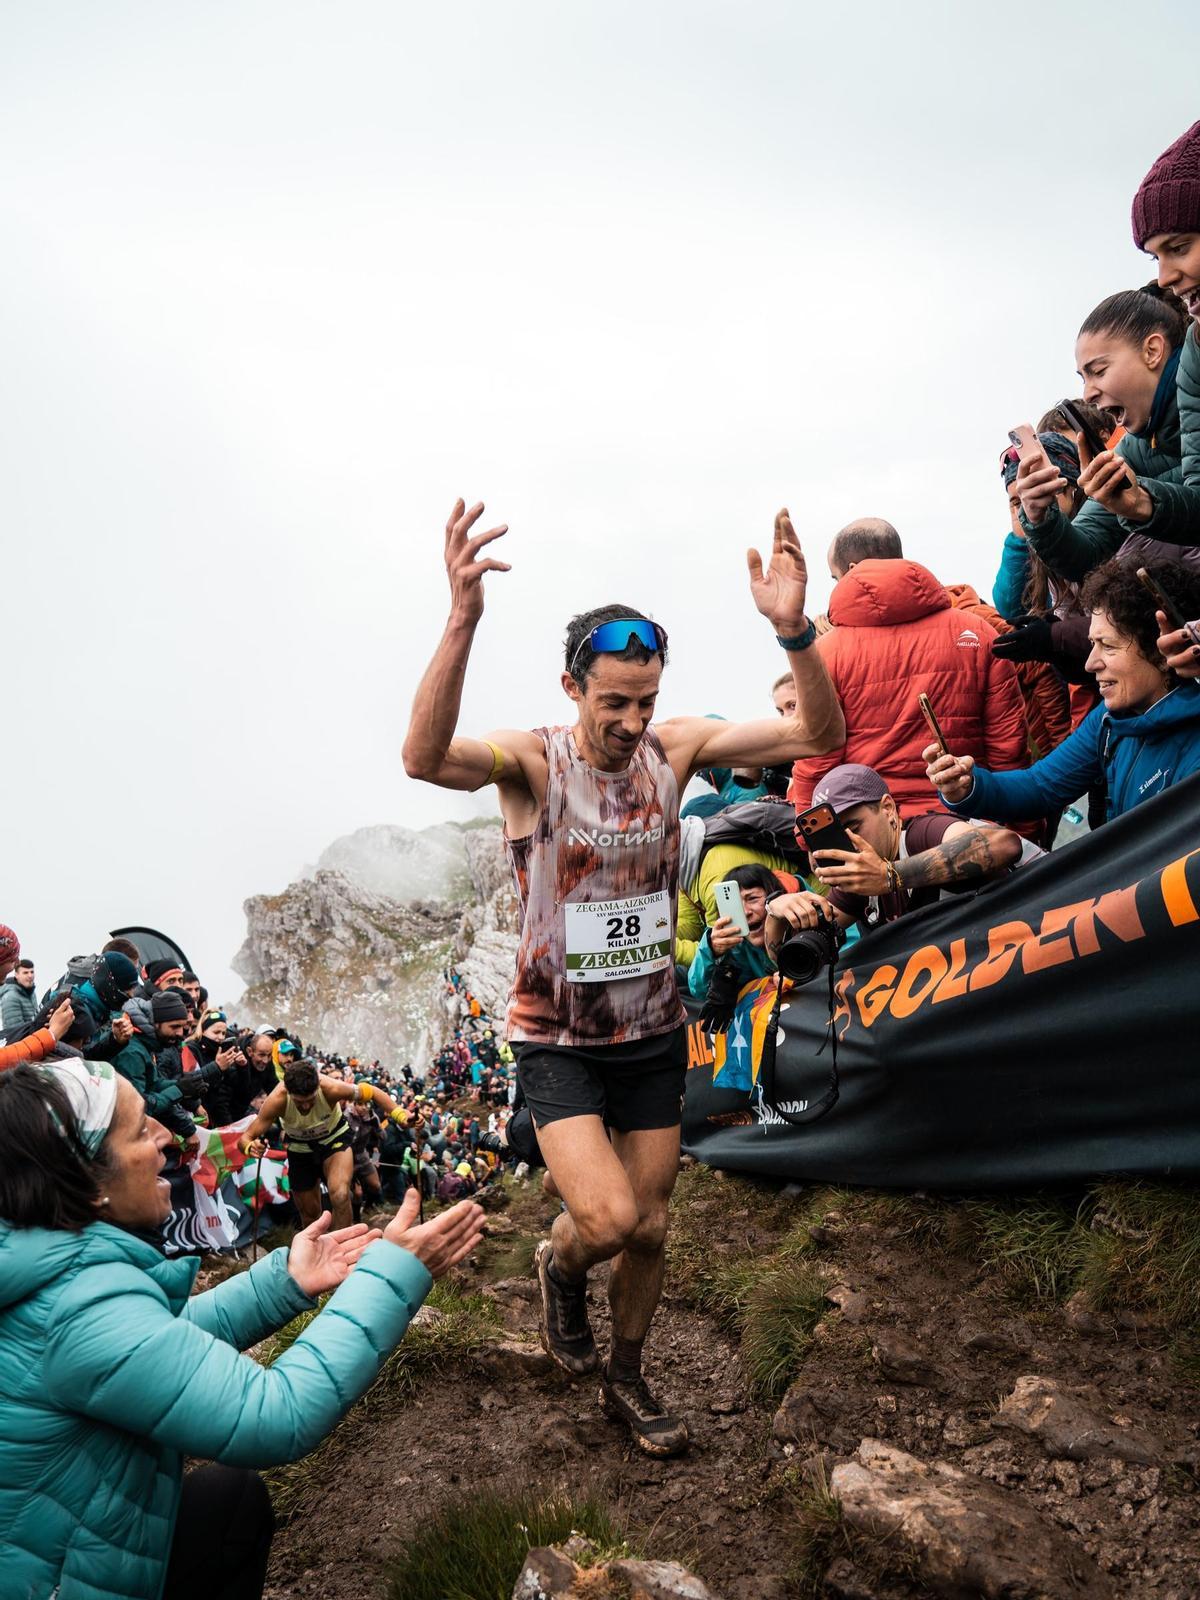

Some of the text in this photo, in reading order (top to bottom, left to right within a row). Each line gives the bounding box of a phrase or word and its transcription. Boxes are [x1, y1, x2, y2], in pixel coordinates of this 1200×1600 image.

[576, 893, 664, 913] ZEGAMA-AIZKORRI
[606, 915, 641, 940] 28
[607, 937, 640, 948] KILIAN
[580, 944, 662, 969] ZEGAMA
[855, 880, 1146, 1028] GOLDEN
[604, 967, 641, 978] SALOMON
